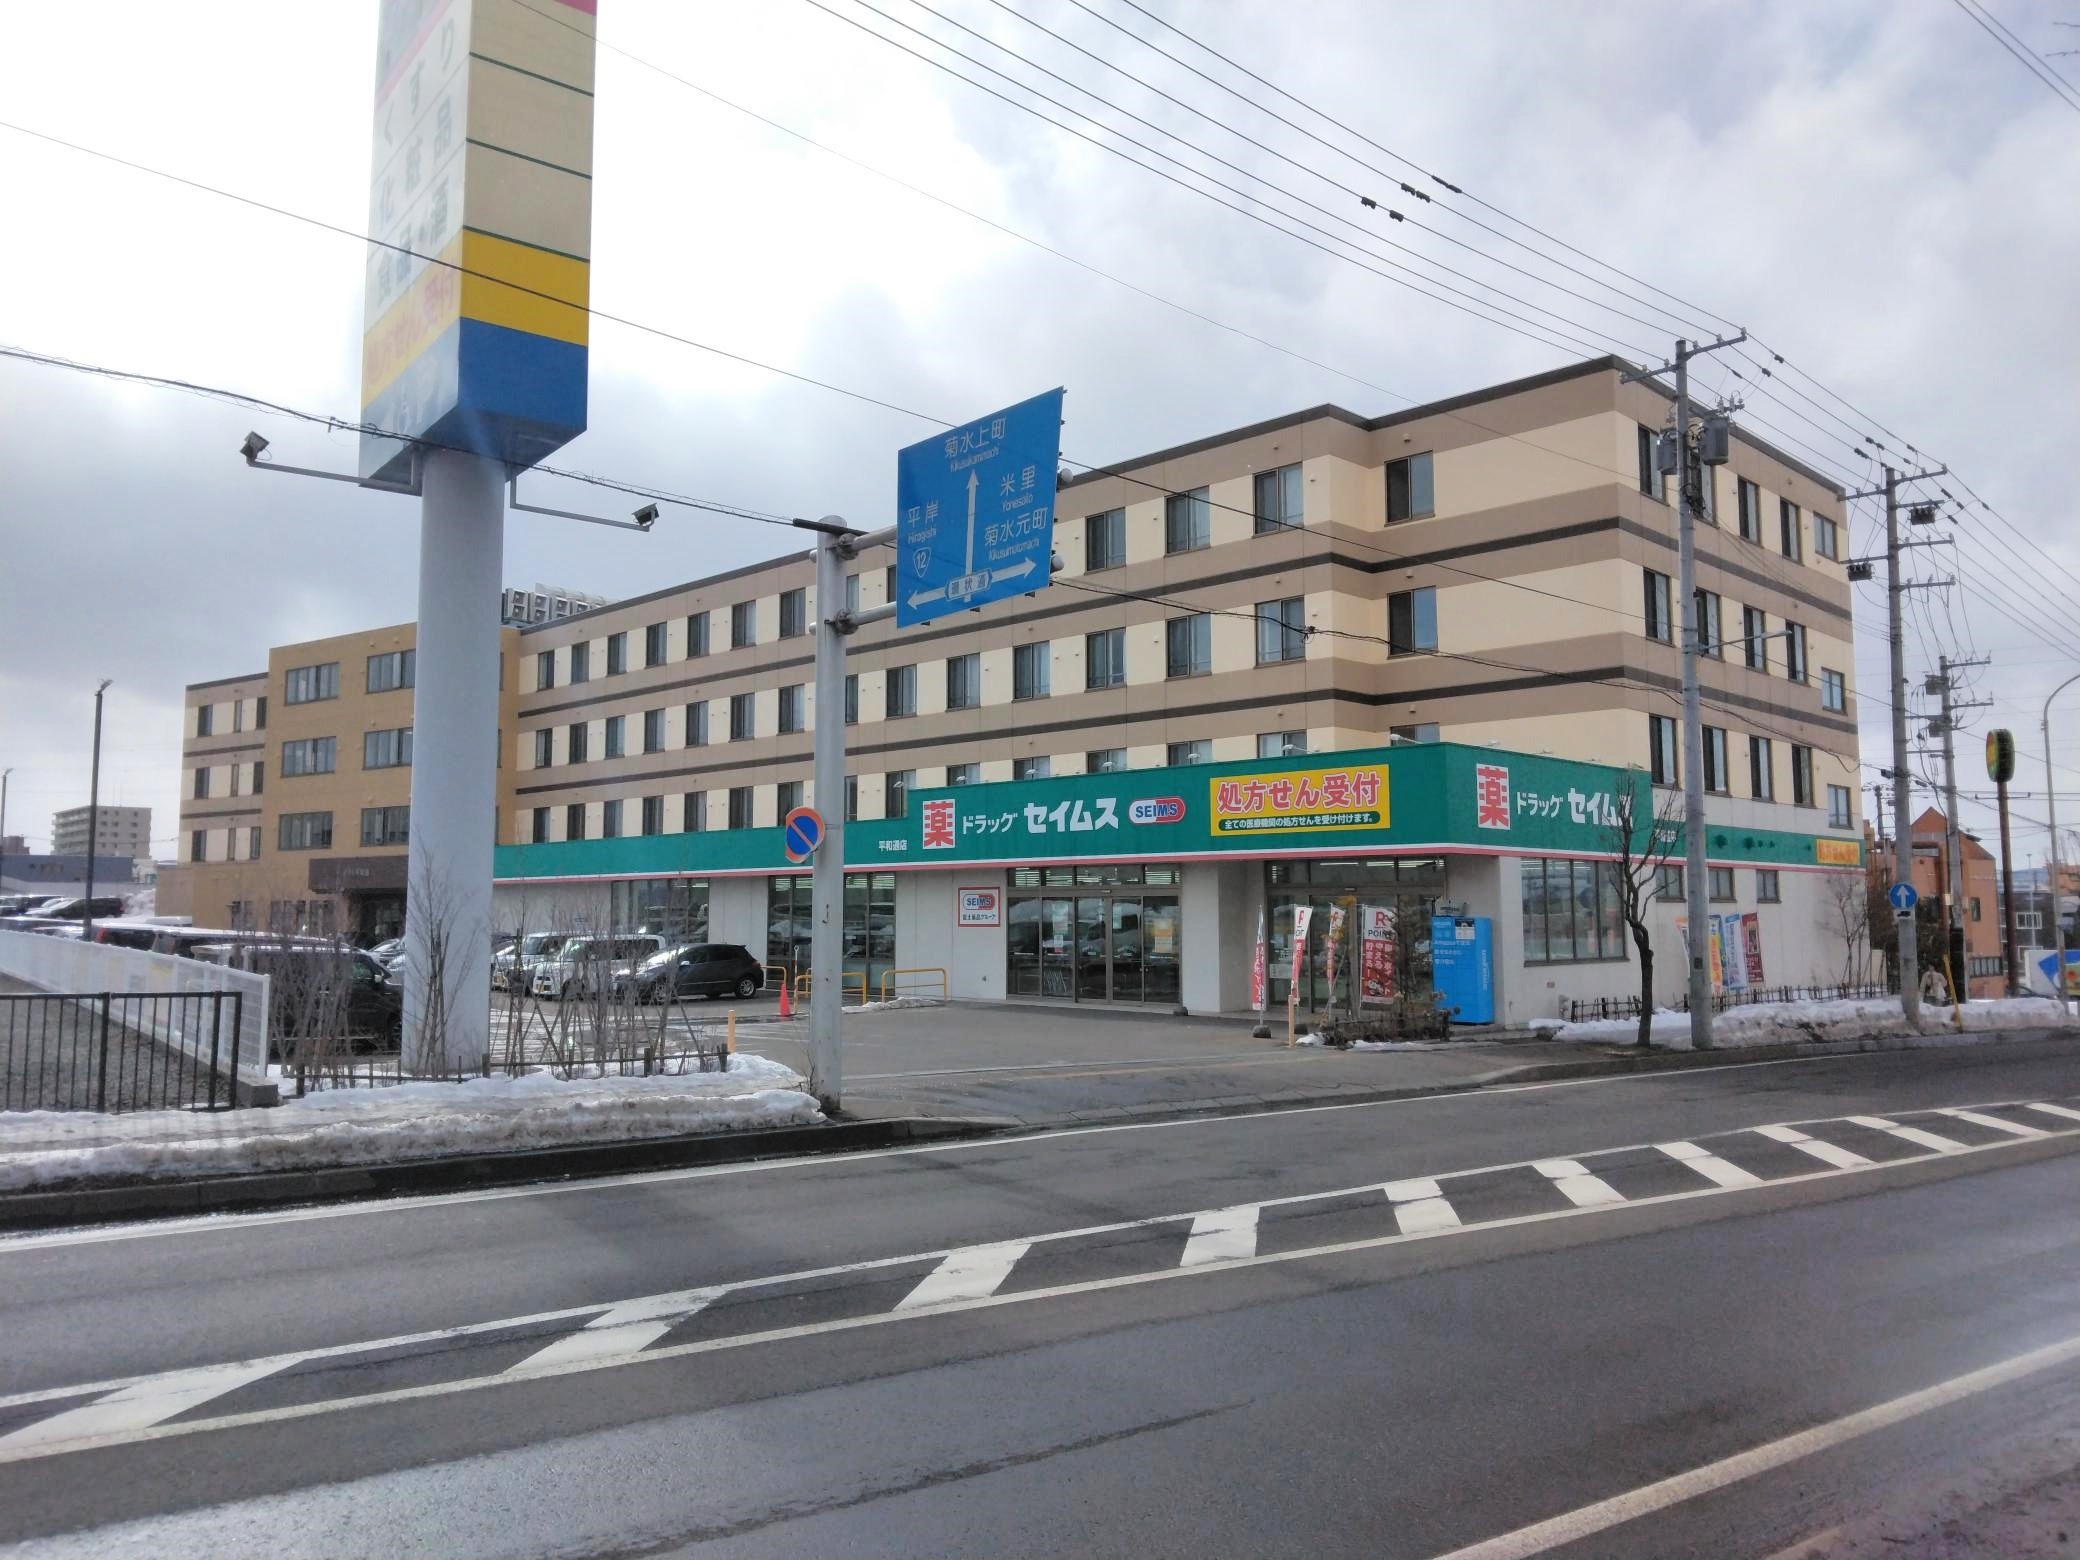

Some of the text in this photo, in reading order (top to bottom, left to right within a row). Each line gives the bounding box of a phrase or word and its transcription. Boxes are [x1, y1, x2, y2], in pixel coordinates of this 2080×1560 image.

[944, 416, 1006, 457] 菊水上町
[1000, 465, 1036, 496] 米里
[907, 499, 939, 529] 平岸
[984, 507, 1049, 546] 菊水元町
[916, 551, 927, 569] 12
[1217, 771, 1381, 814] 処方せん受付
[1478, 766, 1509, 828] 薬
[1516, 791, 1564, 818] ドラッグ
[924, 798, 1119, 847] 薬 ドラッグ セイムス
[1135, 802, 1178, 818] SEIMS
[966, 897, 992, 906] SEIMS
[1368, 929, 1393, 938] POI
